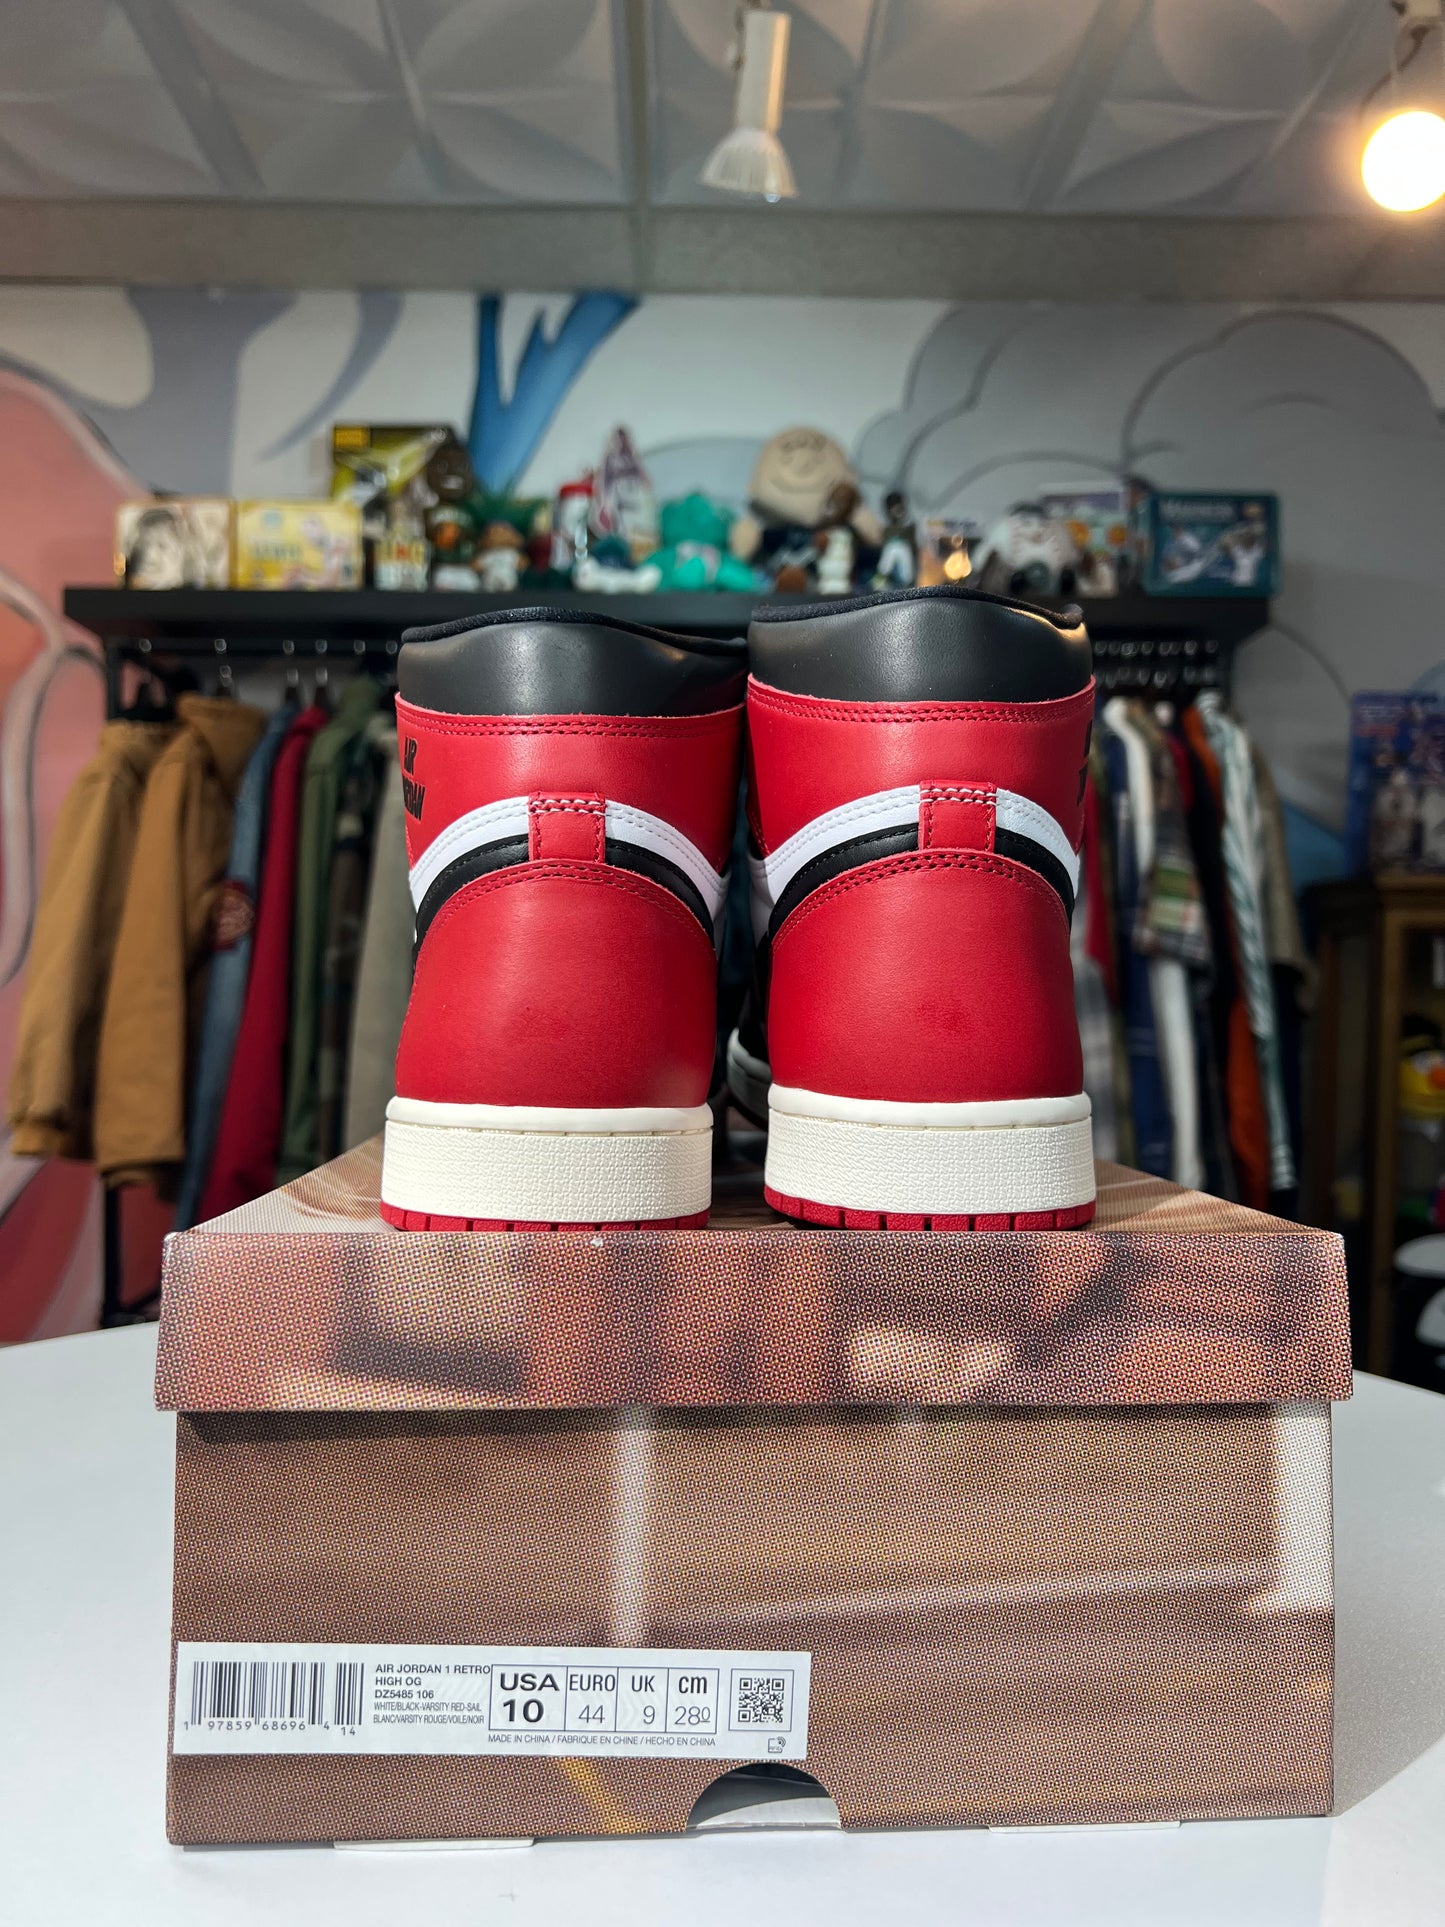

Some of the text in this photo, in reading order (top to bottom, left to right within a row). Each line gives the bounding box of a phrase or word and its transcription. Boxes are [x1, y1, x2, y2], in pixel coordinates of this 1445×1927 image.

[375, 1664, 491, 1675] AIR JORDAN 1 RETRO
[375, 1676, 422, 1686] HIGH OG
[499, 1673, 560, 1692] USA
[568, 1674, 616, 1692] EURO
[631, 1675, 655, 1693] UK
[678, 1676, 708, 1694] cm
[374, 1689, 434, 1699] DZ5485 106
[374, 1701, 450, 1711] WHITE/BLACK-VARSITY
[502, 1698, 545, 1723] 10
[578, 1704, 606, 1725] 44
[642, 1705, 656, 1725] 9
[184, 1721, 330, 1731] 1 97859 68696 4
[341, 1726, 357, 1736] 14
[488, 1734, 513, 1743] MADE
[514, 1735, 522, 1743] IN
[524, 1735, 551, 1744] CHINA
[557, 1735, 599, 1745] FABRIQUE
[600, 1736, 612, 1745] EN
[613, 1736, 639, 1745] CHINE
[645, 1736, 675, 1746] HECHO
[676, 1737, 688, 1746] EN
[689, 1737, 716, 1746] CHINA
